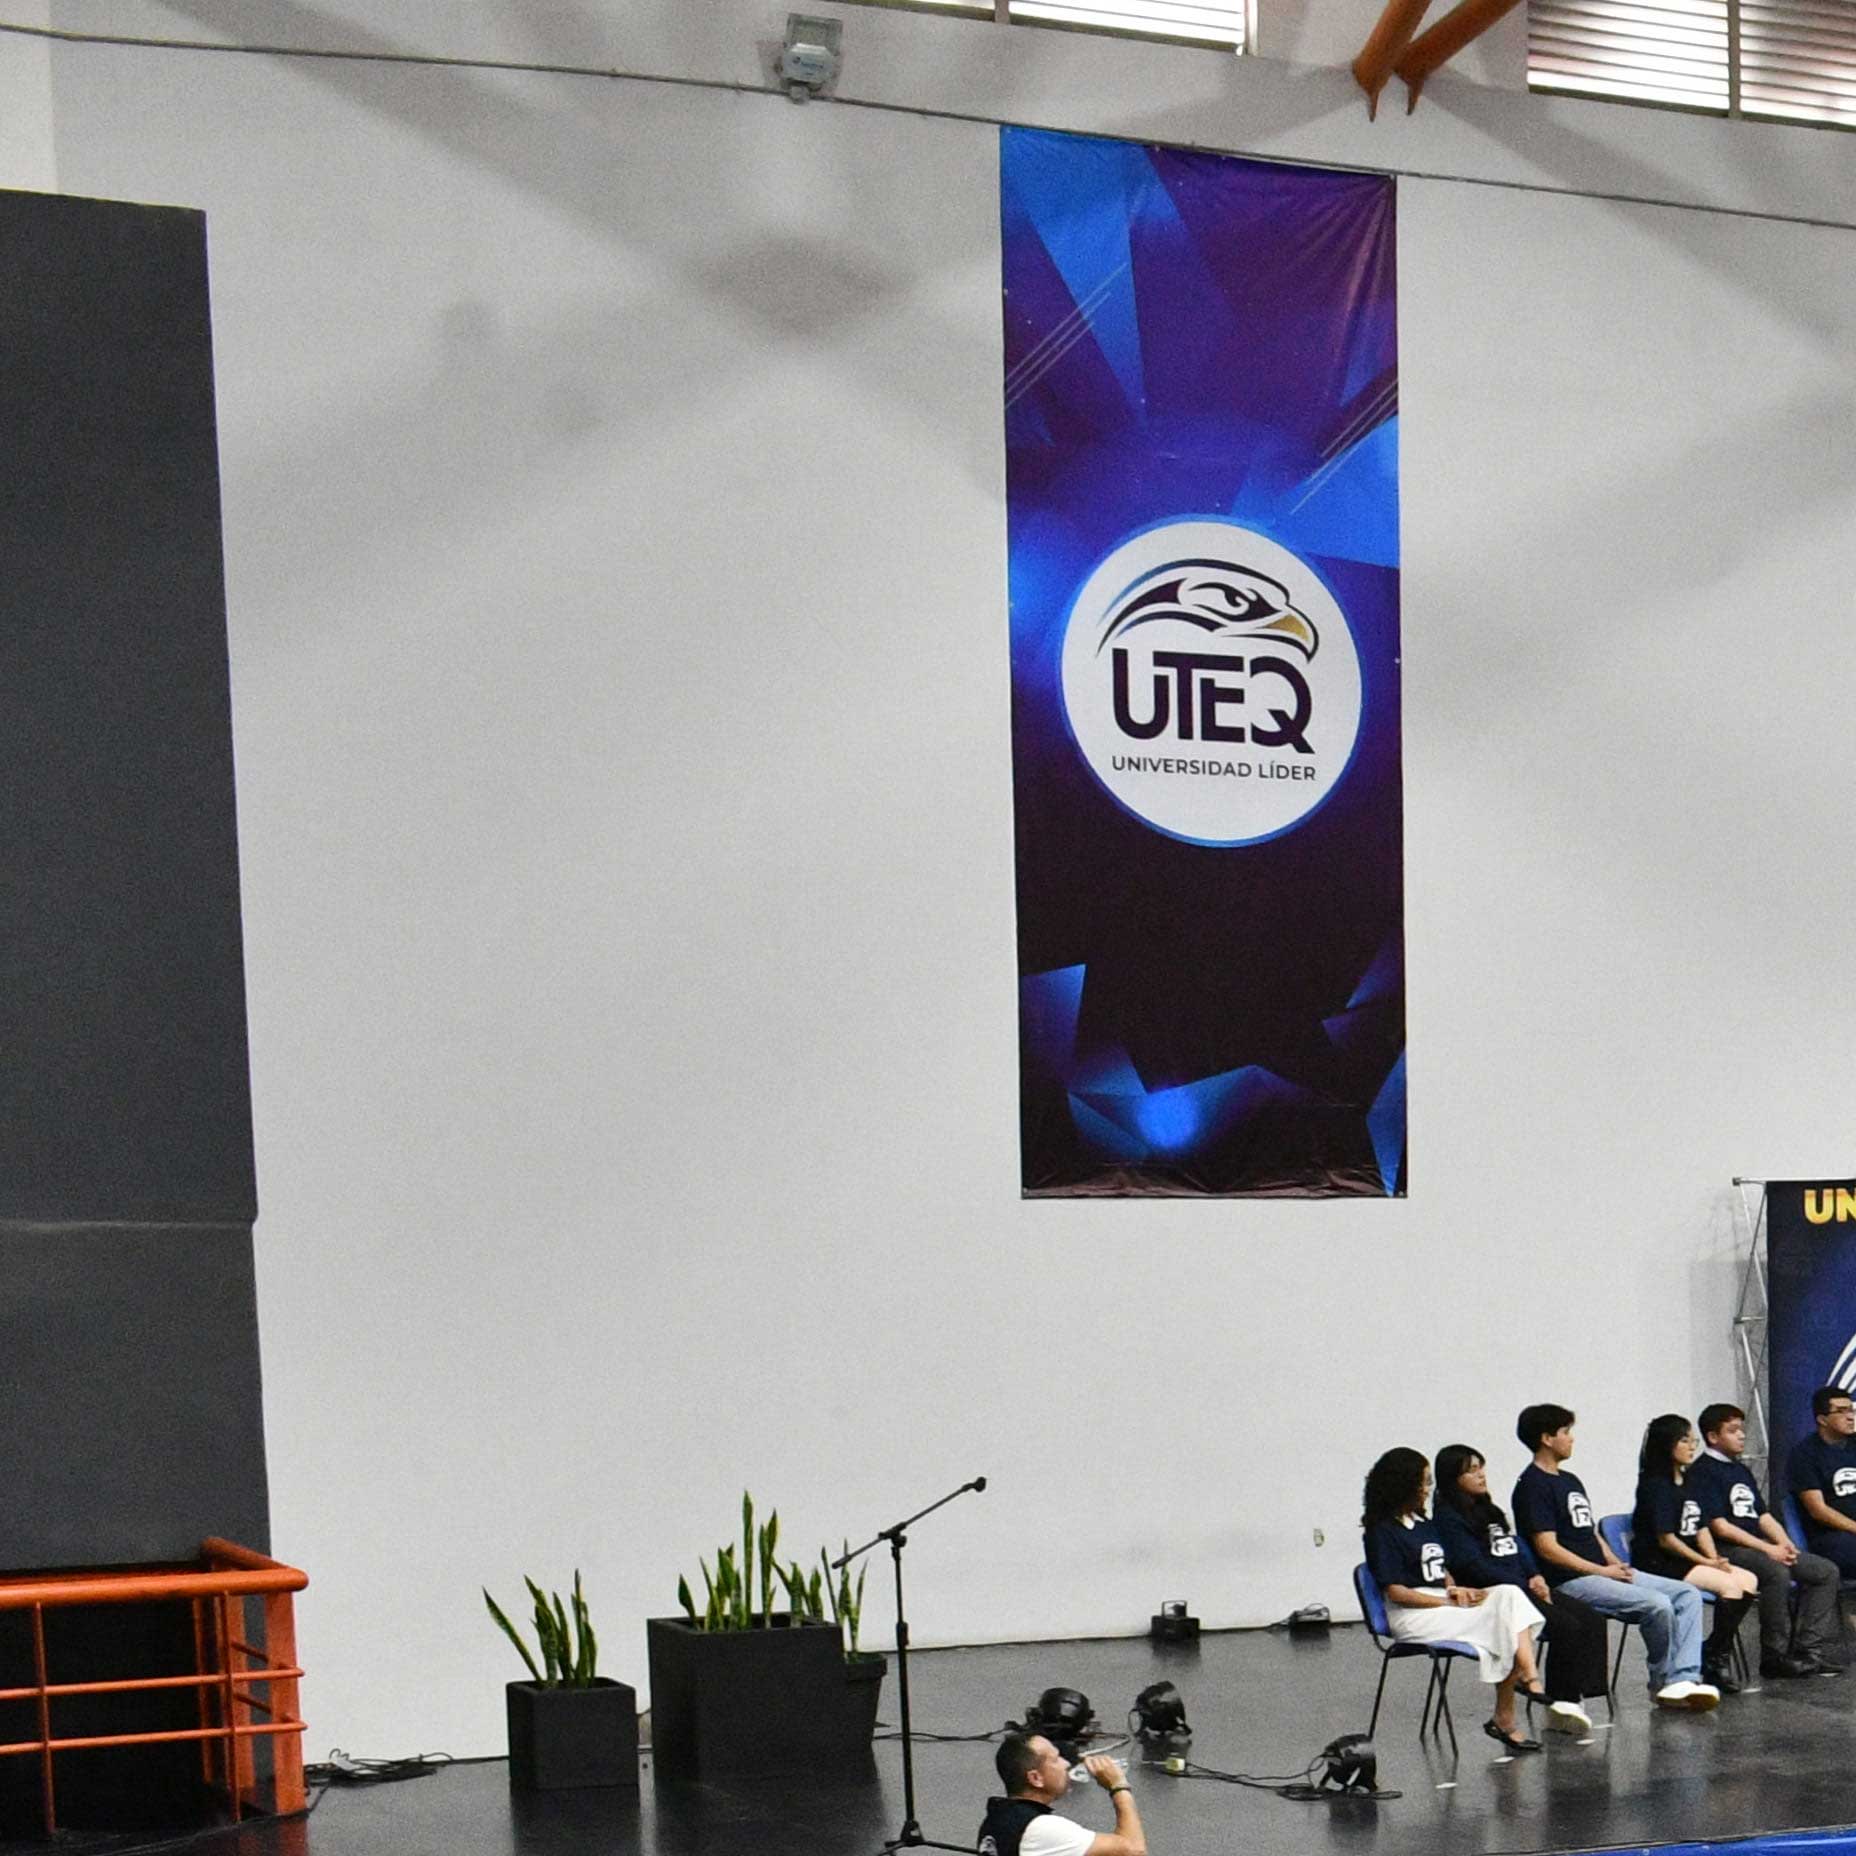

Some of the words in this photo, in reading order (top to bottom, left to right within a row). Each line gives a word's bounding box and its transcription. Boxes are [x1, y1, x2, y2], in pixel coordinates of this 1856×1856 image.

[1112, 648, 1316, 754] UTEQ
[1112, 755, 1252, 778] UNIVERSIDAD
[1258, 760, 1317, 783] LÍDER
